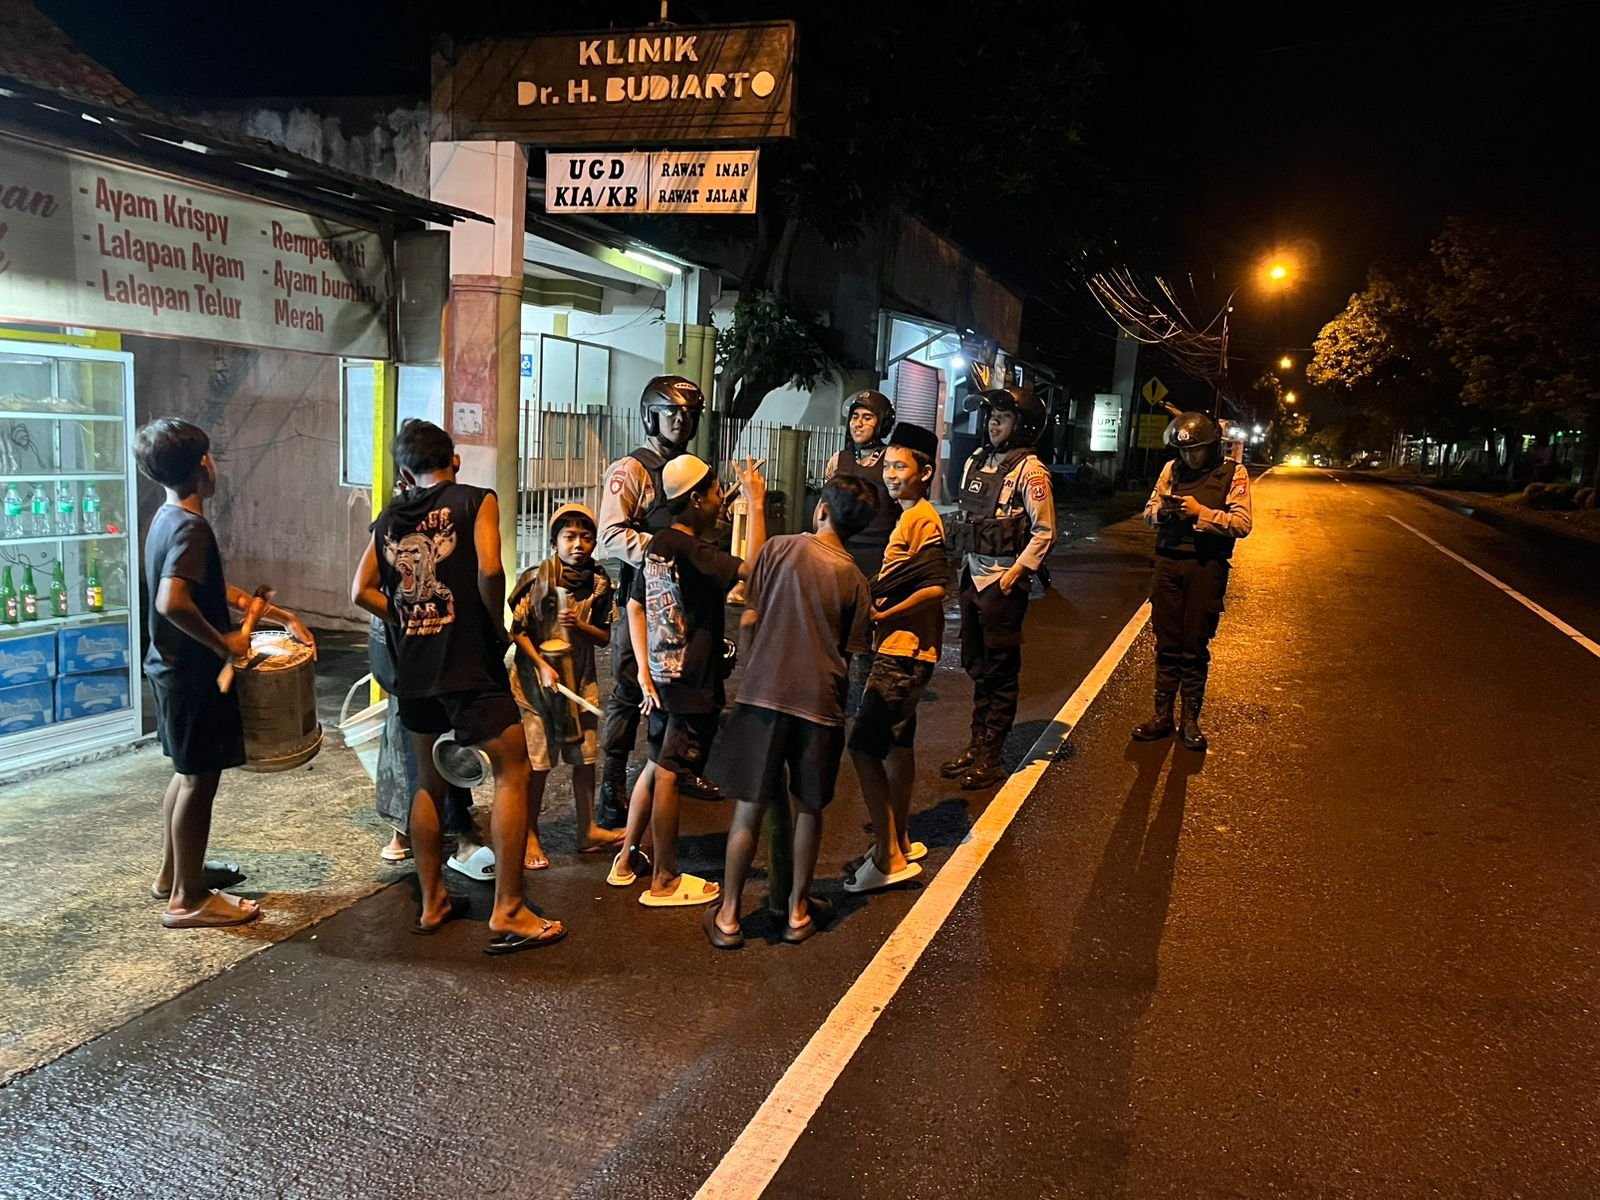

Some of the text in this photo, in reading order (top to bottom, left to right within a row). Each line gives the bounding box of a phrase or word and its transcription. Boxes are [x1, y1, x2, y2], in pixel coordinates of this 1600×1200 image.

[579, 36, 698, 66] KLINIK
[517, 71, 775, 106] Dr. H. BUDIARTO
[569, 159, 625, 180] UGD
[661, 163, 749, 177] RAWAT INAP
[95, 177, 158, 223] Ayam
[163, 194, 229, 245] Krispy
[554, 186, 638, 207] KIA/KB
[658, 188, 748, 204] RAWAT JALAN
[98, 223, 187, 272] Lalapan
[192, 242, 245, 283] Ayam
[102, 269, 191, 316] Lalapan
[194, 284, 242, 319] Telur
[274, 260, 318, 298] Ayam
[274, 299, 324, 332] Merah
[1097, 418, 1116, 427] UPT
